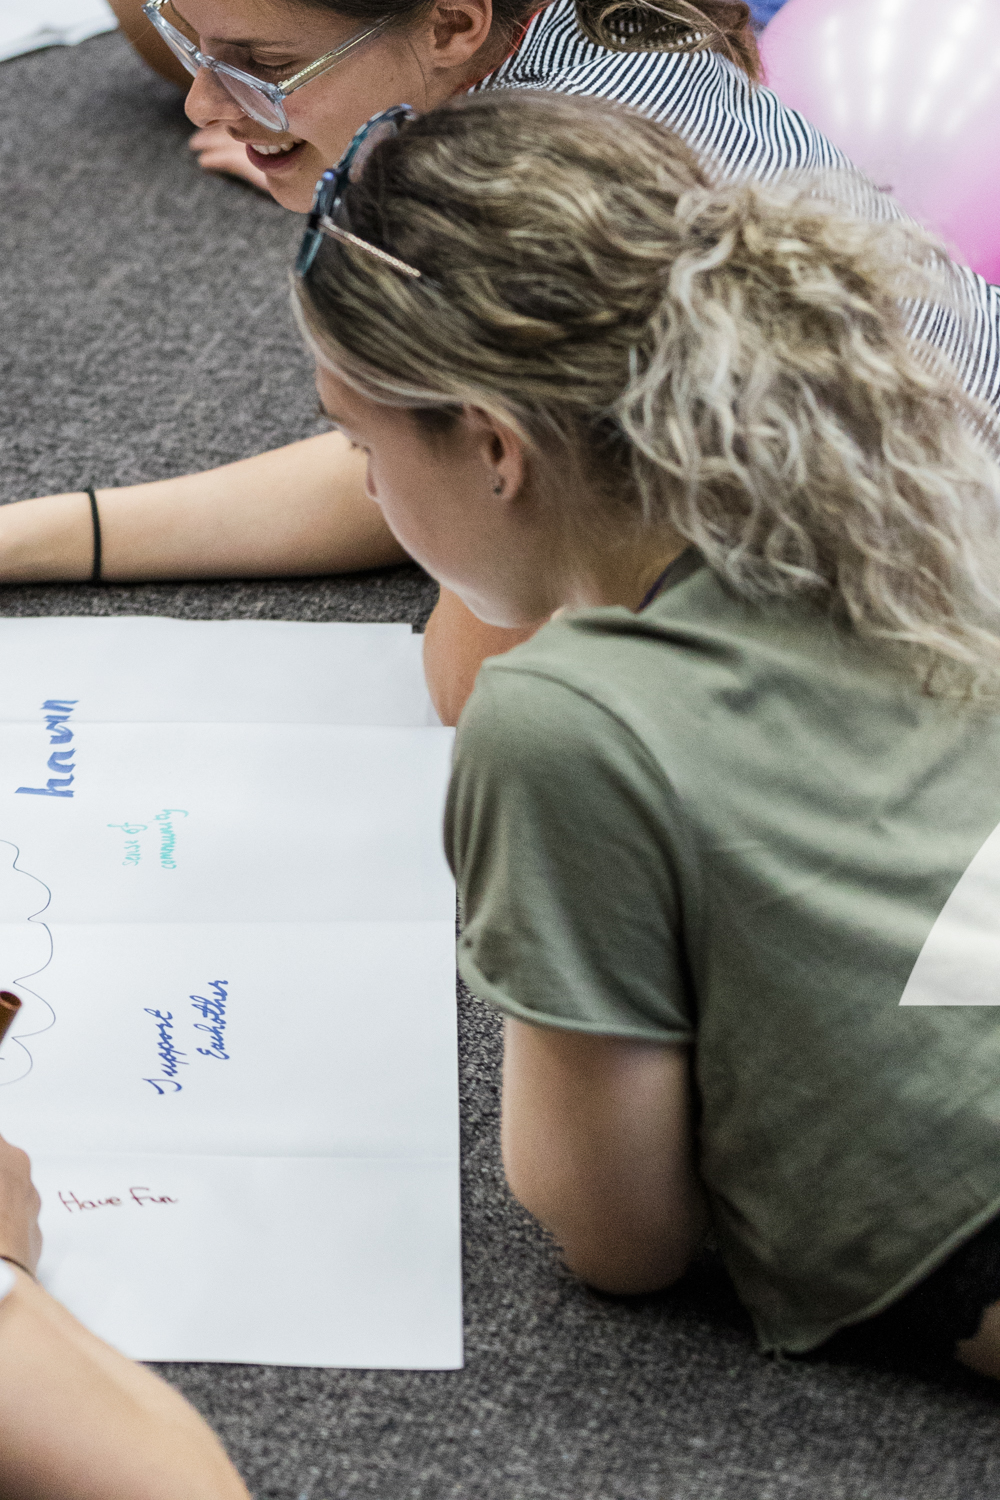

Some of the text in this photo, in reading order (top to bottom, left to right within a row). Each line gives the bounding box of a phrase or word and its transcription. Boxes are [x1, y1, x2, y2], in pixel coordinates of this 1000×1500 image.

[107, 821, 148, 867] sense of
[152, 809, 190, 869] community
[189, 980, 230, 1060] Eachother
[141, 1008, 189, 1095] Support
[58, 1186, 178, 1213] Have Fun
